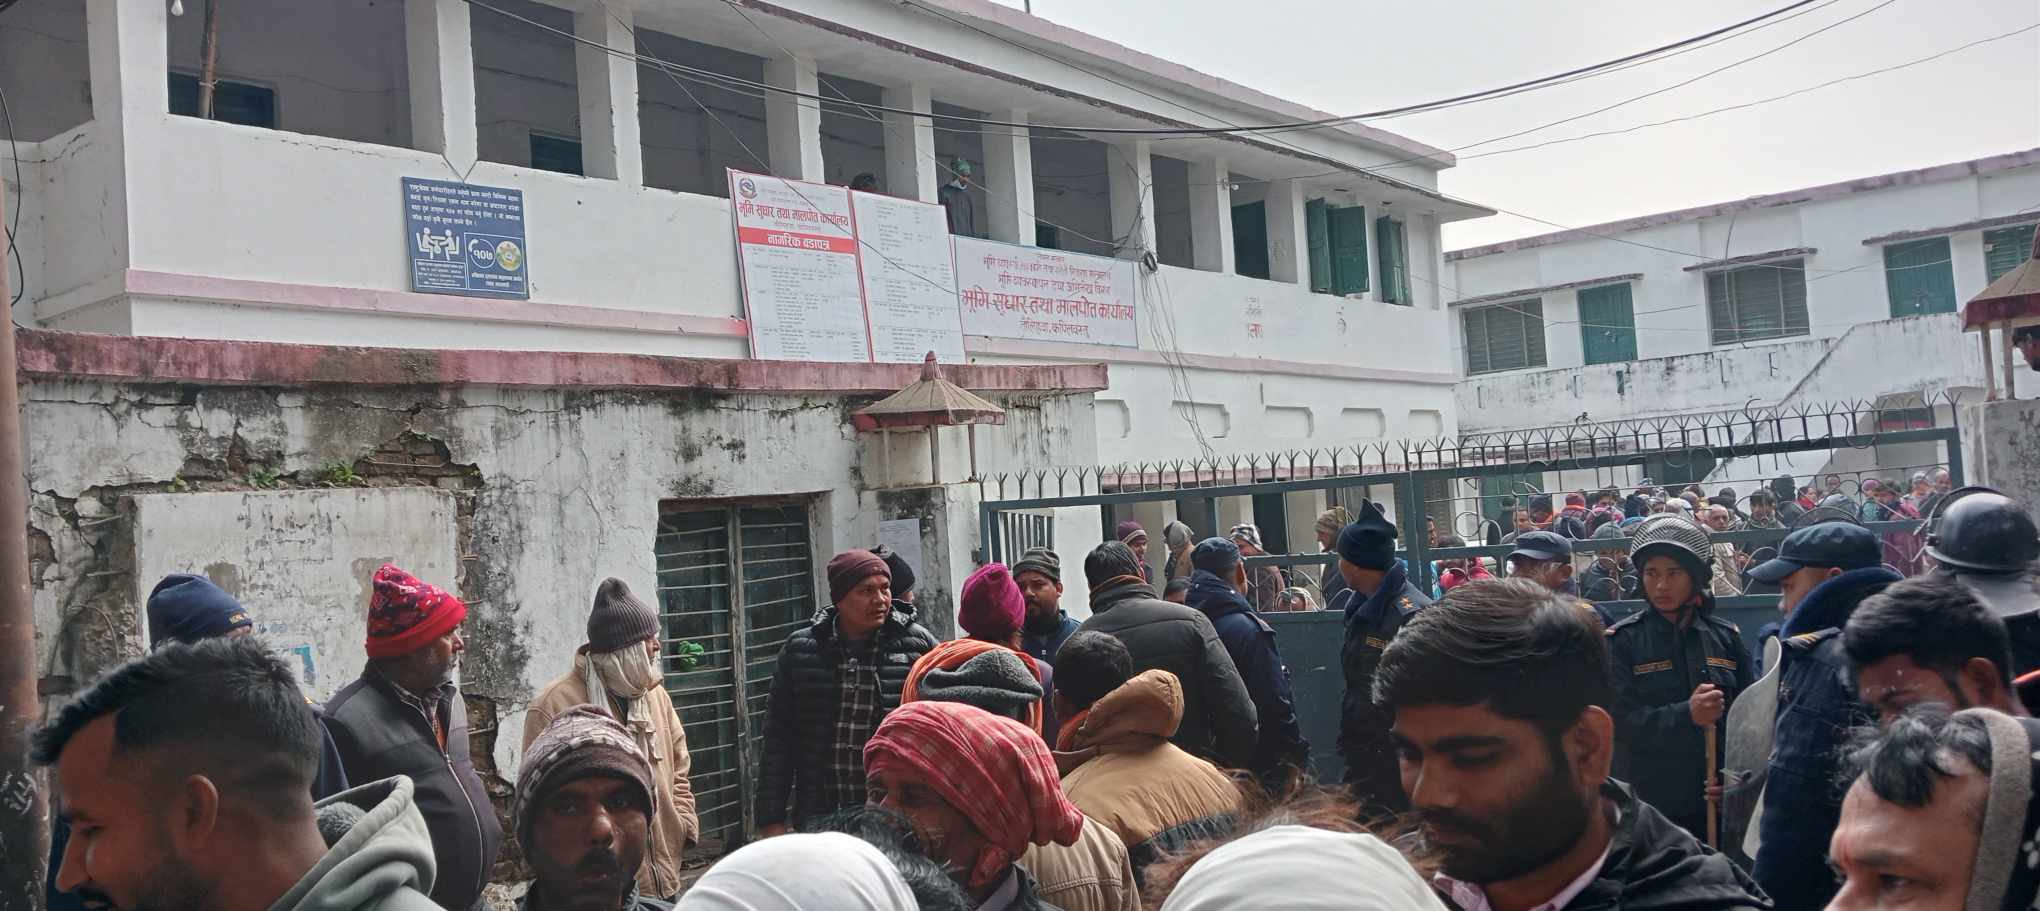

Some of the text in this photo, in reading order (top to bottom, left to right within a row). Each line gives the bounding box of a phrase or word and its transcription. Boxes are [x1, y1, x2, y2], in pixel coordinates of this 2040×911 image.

[768, 232, 801, 248] नागरिक
[962, 285, 1133, 320] भूमि सुधार तथा मालपोत कार्यालय
